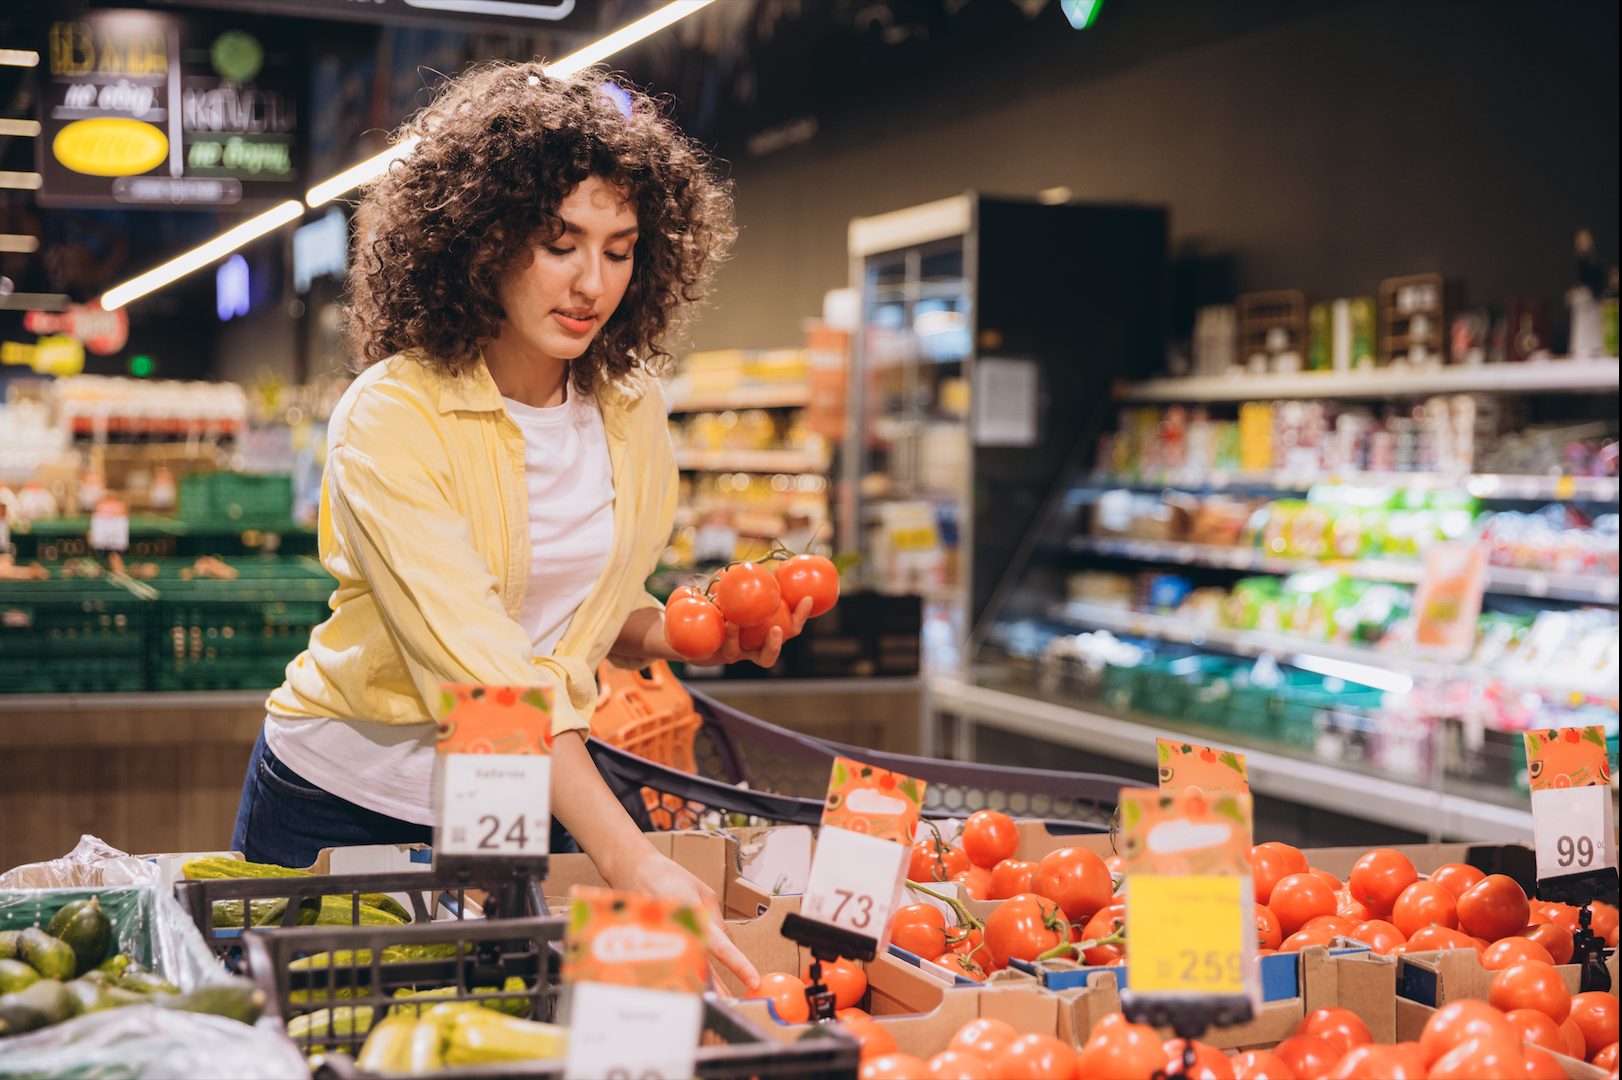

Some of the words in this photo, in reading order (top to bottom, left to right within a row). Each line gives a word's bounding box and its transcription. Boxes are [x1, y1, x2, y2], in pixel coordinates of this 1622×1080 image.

[477, 814, 529, 849] 24
[1557, 835, 1594, 868] 99
[831, 888, 874, 929] 73
[1179, 948, 1243, 985] 259
